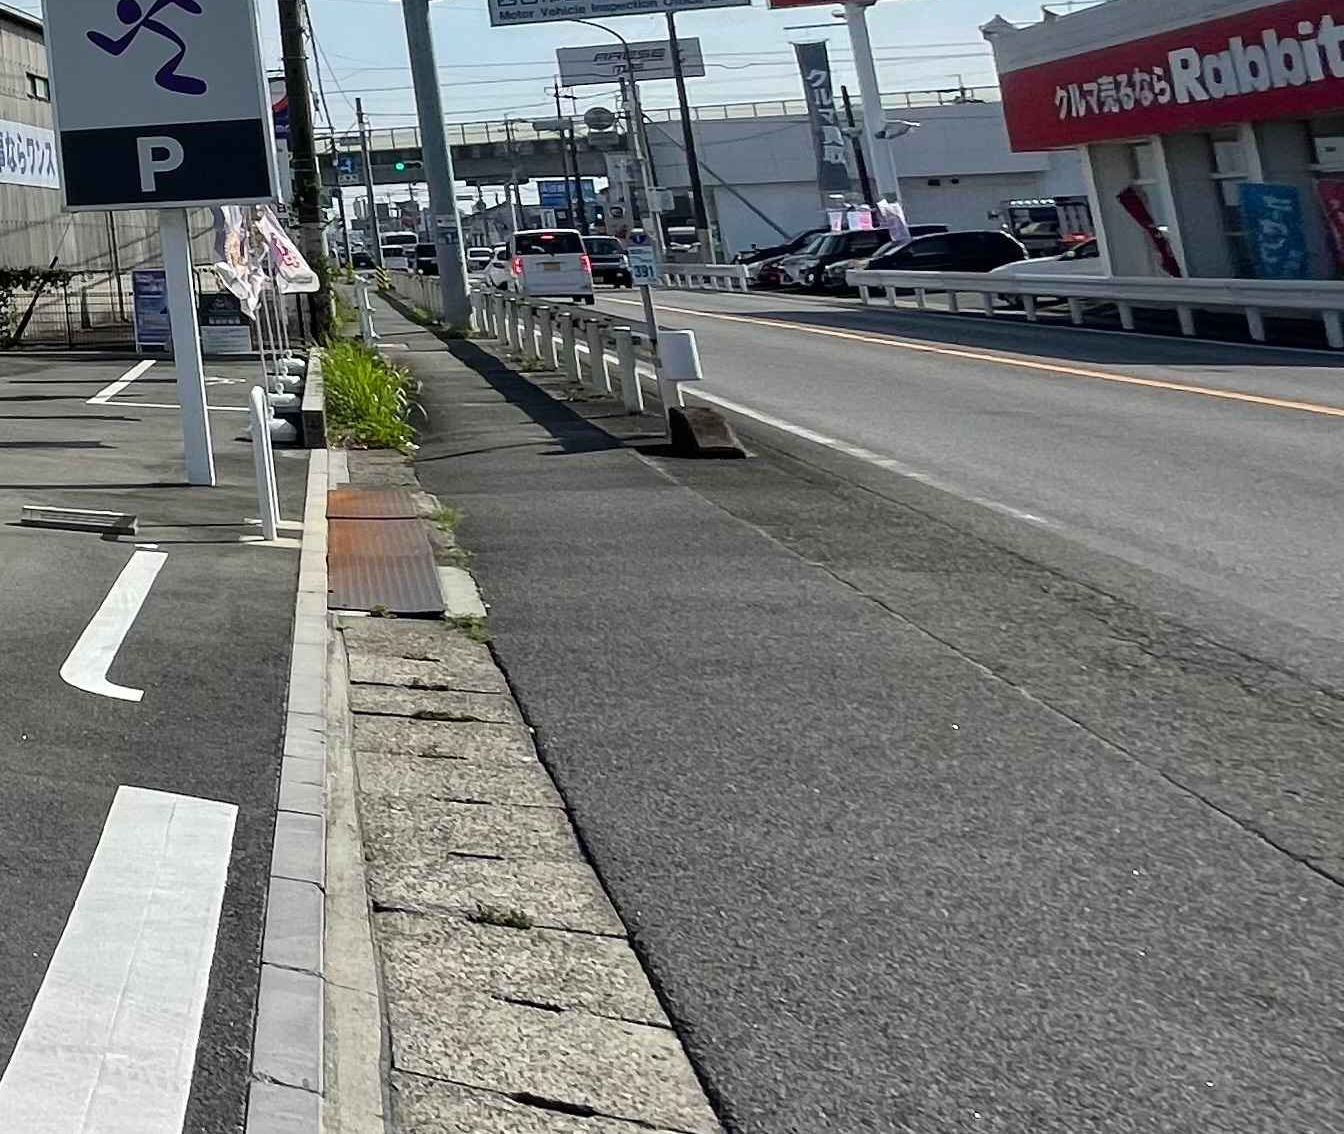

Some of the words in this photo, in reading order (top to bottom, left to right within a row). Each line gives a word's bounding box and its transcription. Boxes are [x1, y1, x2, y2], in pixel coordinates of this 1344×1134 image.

[499, 8, 534, 21] Motor
[540, 4, 586, 17] Vehicle
[1054, 66, 1171, 119] クルマ売るなら
[1168, 15, 1343, 104] Rabbit
[136, 136, 184, 192] P
